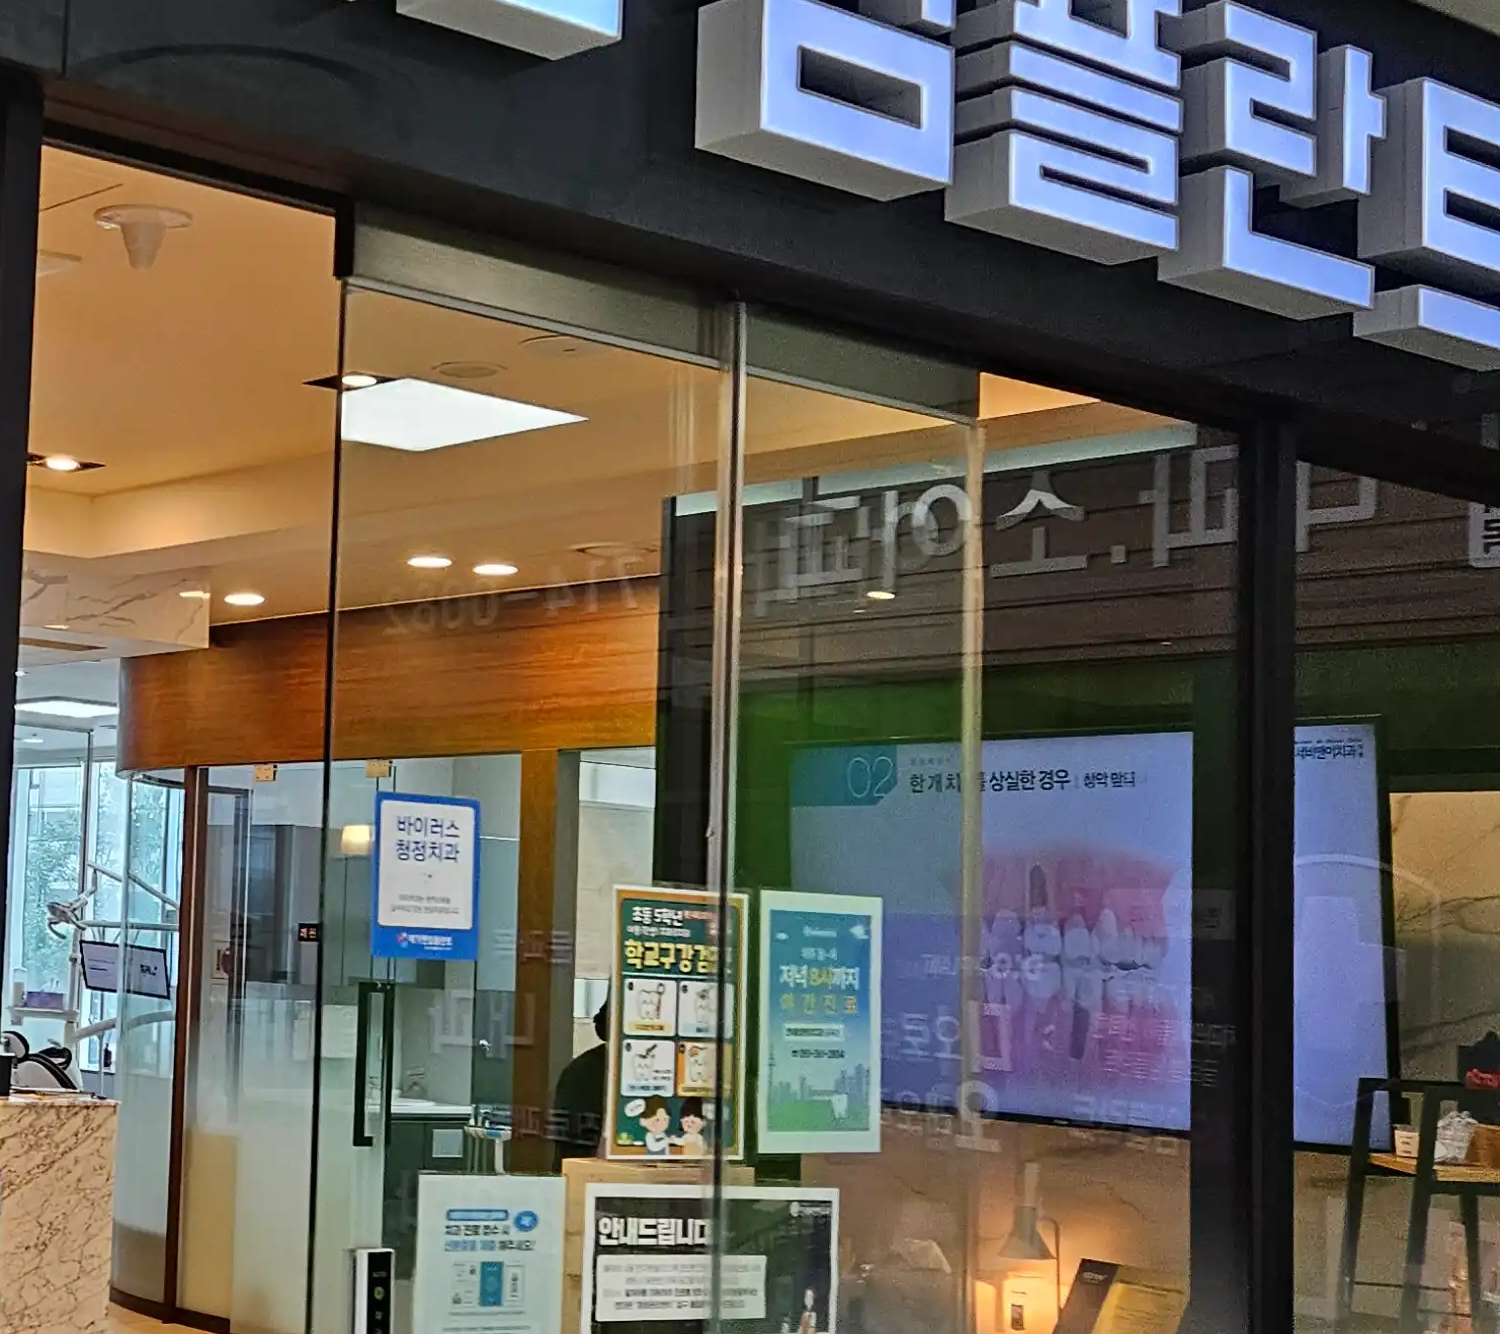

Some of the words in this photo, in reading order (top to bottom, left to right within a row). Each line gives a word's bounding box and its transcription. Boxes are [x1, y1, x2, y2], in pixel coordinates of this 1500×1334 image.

[847, 756, 894, 799] 02
[989, 770, 1036, 792] 상실한
[1038, 769, 1071, 791] 경우
[396, 815, 461, 838] 바이러스
[396, 839, 461, 864] 청정치과
